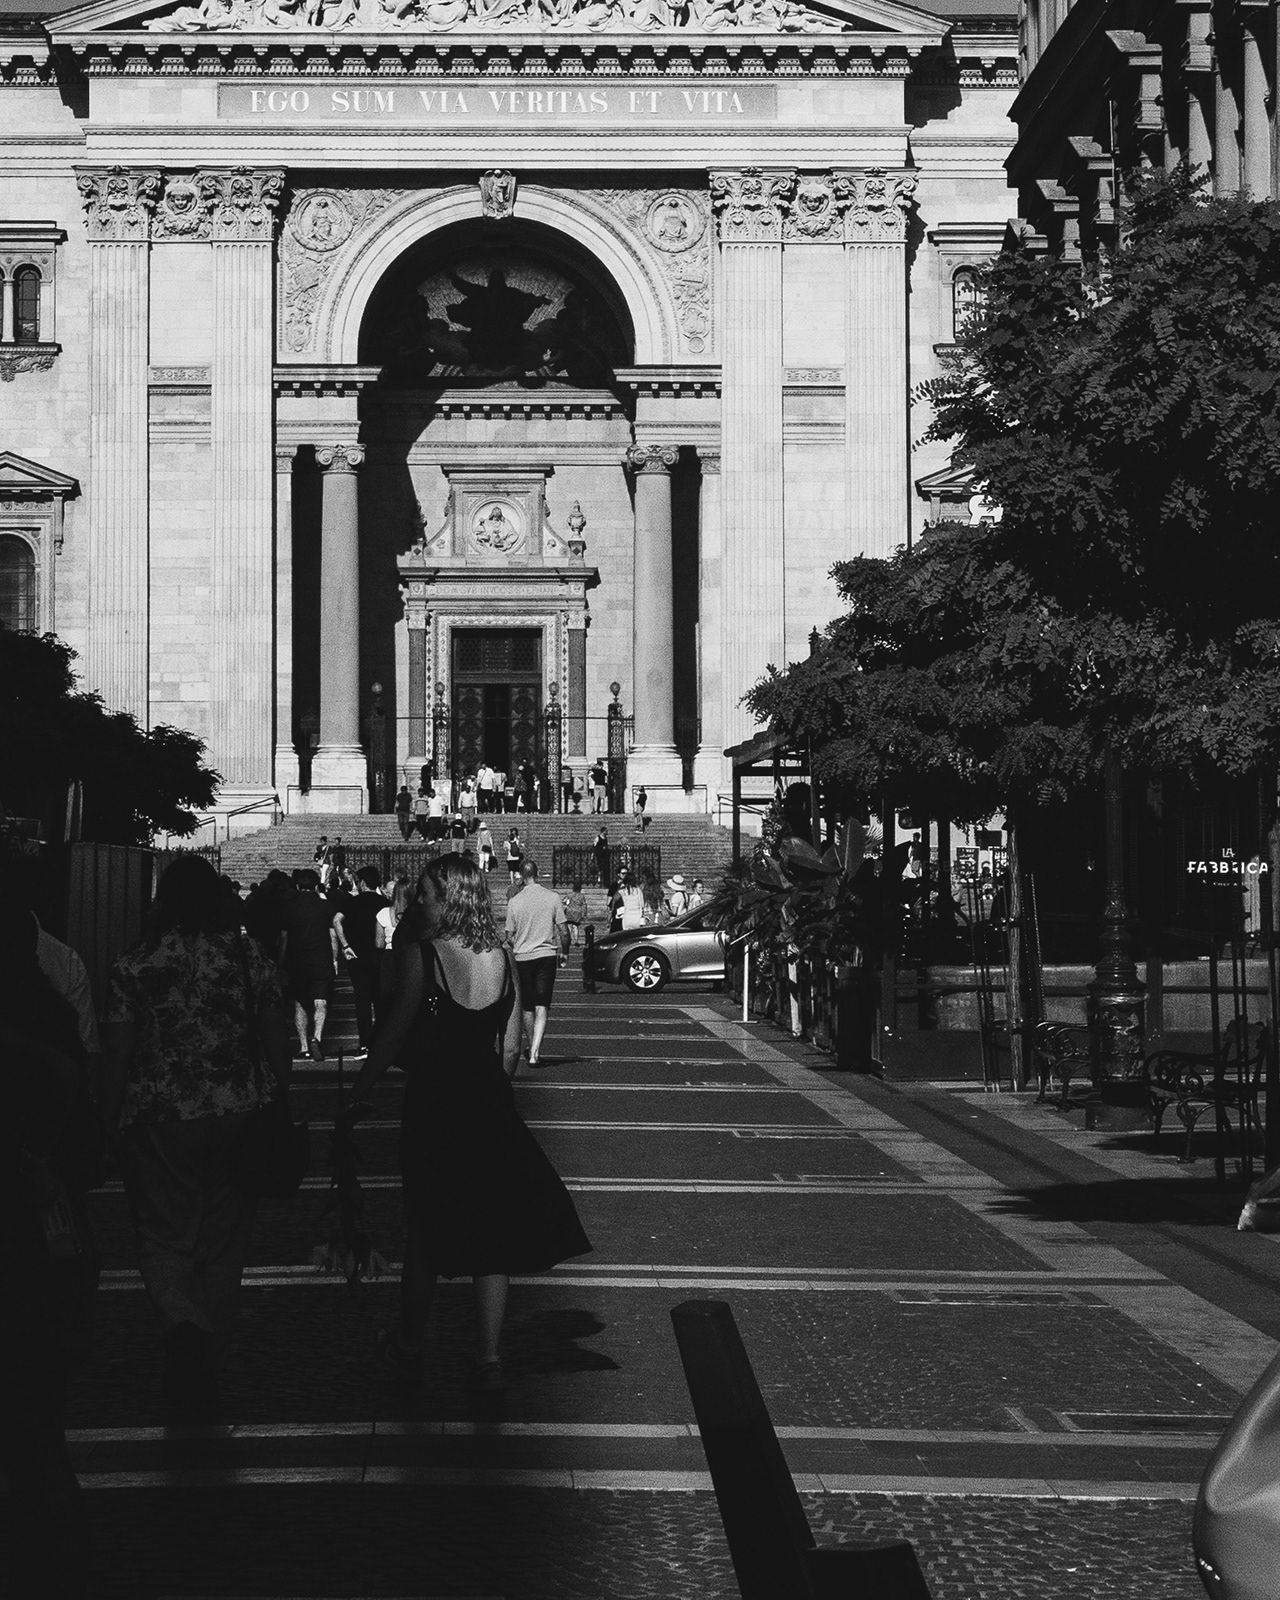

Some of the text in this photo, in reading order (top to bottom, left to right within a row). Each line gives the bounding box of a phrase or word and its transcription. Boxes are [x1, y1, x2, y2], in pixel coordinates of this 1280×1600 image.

[249, 90, 745, 114] EGO SUM VIA VERITAS ET VITA
[1222, 847, 1236, 858] LA
